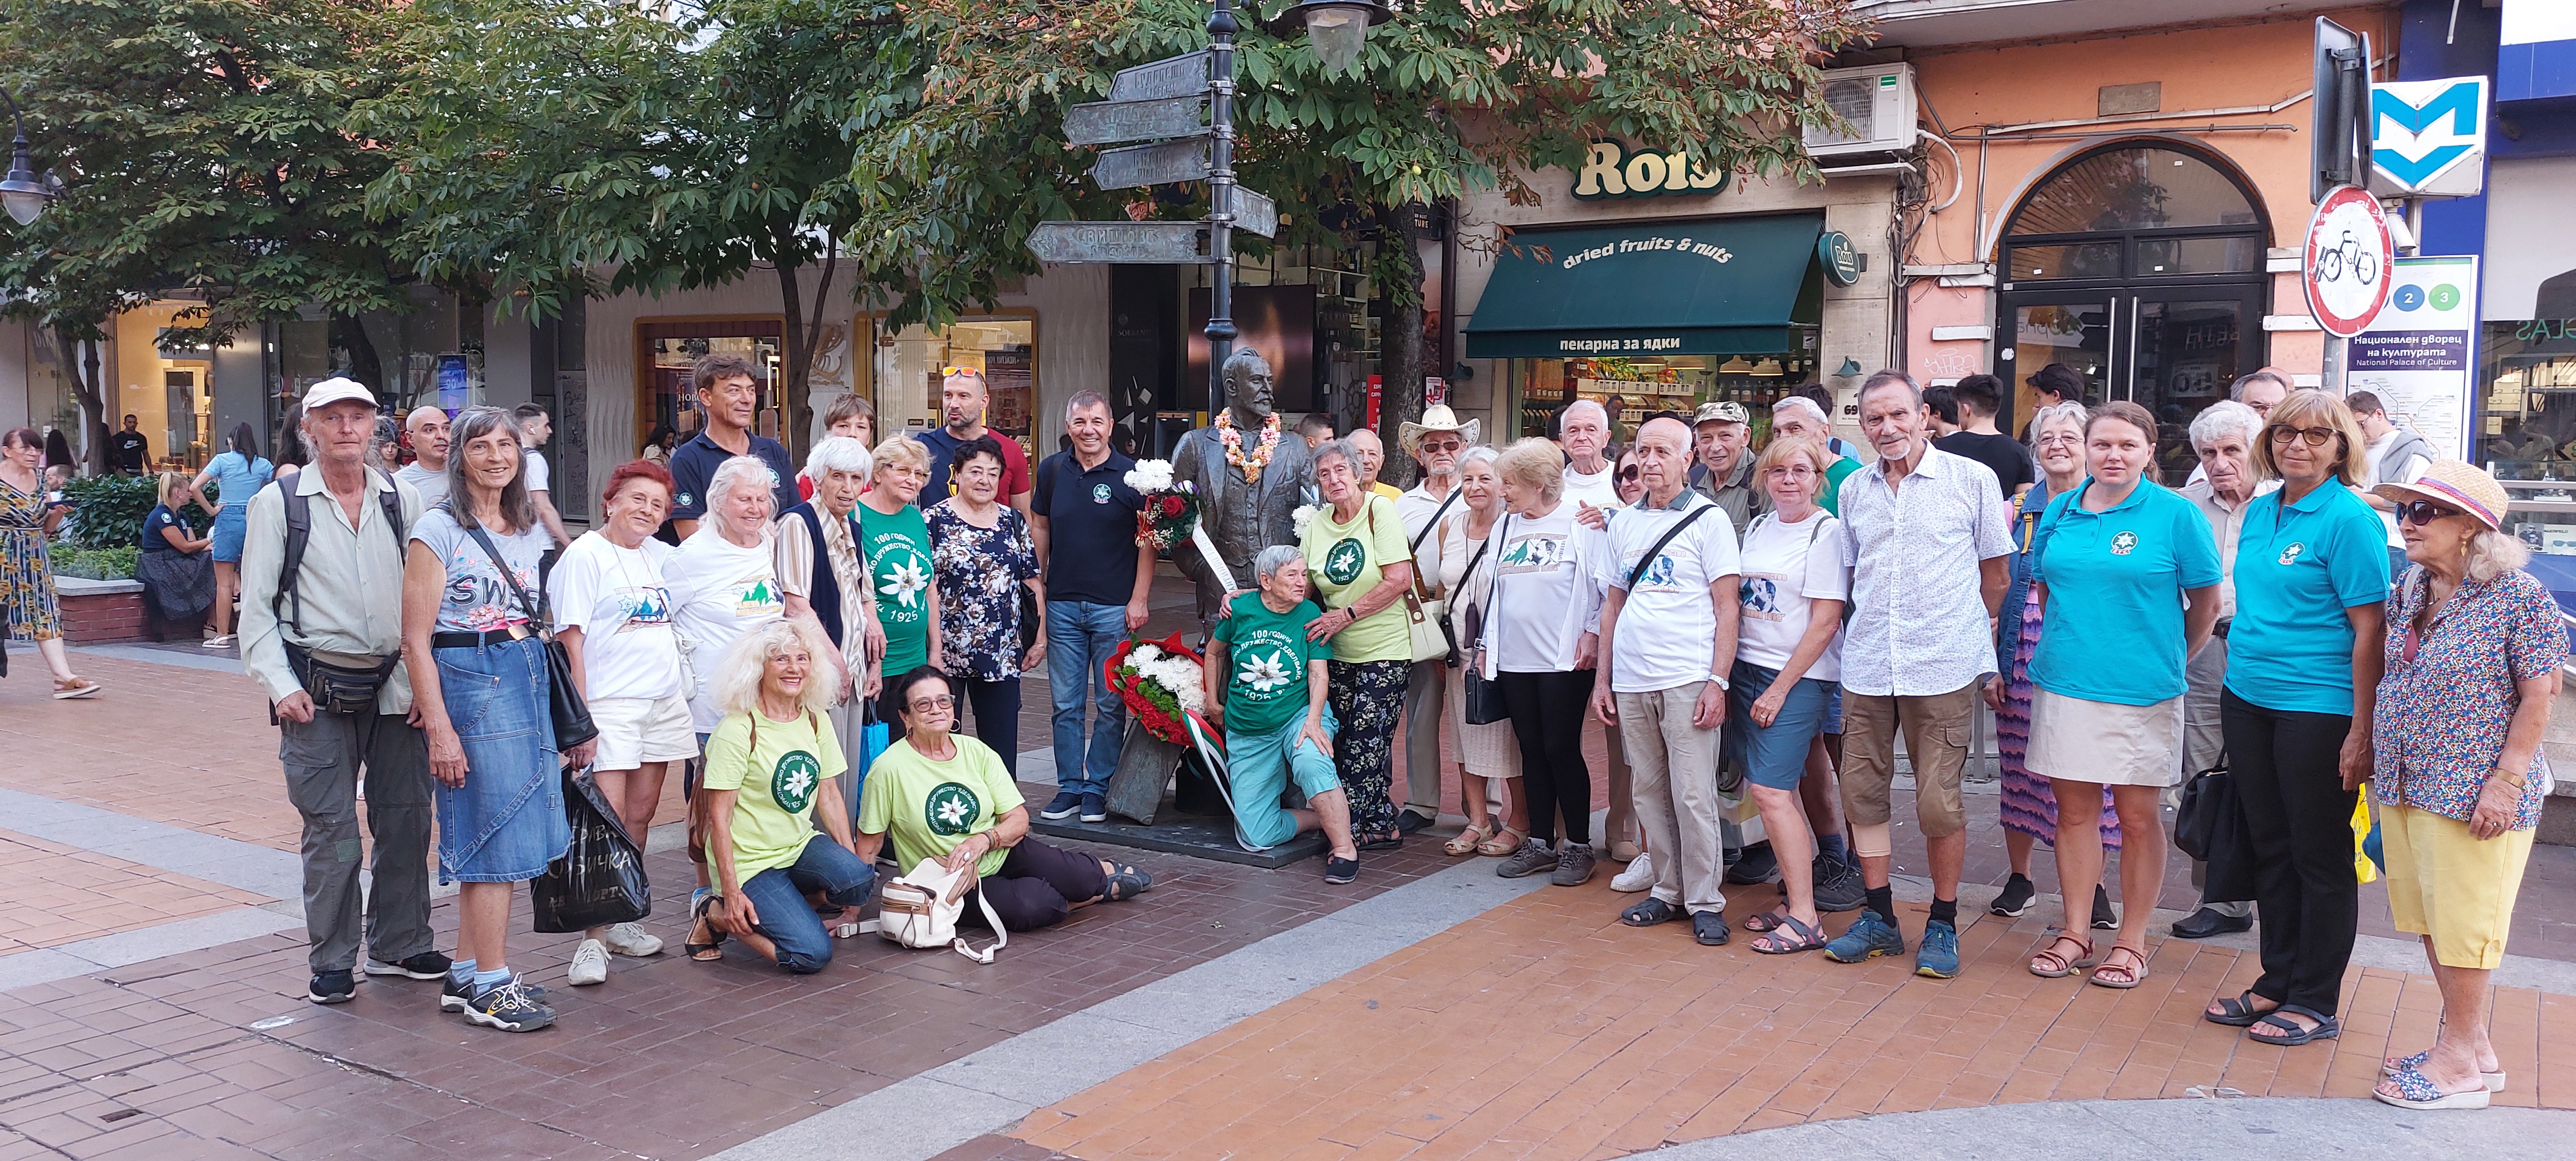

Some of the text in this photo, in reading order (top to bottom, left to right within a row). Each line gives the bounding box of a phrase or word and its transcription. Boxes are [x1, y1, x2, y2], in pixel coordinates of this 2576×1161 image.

[1575, 143, 1721, 195] Rois
[1563, 237, 1733, 269] dried fruits & nuts
[2404, 292, 2449, 304] 2 3
[1560, 338, 1680, 353] пекарна за ядки
[2354, 334, 2462, 345] Национален дворец
[2382, 348, 2446, 358] културата
[1844, 405, 1858, 415] 69
[874, 533, 915, 546] 100 ГОДИНИ
[874, 543, 911, 562] ДРУЖЕСТВО
[890, 609, 918, 622] 1925
[1252, 630, 1268, 639] 100
[1241, 638, 1282, 651] ДРУЖЕСТВО
[1245, 689, 1272, 701] 1925
